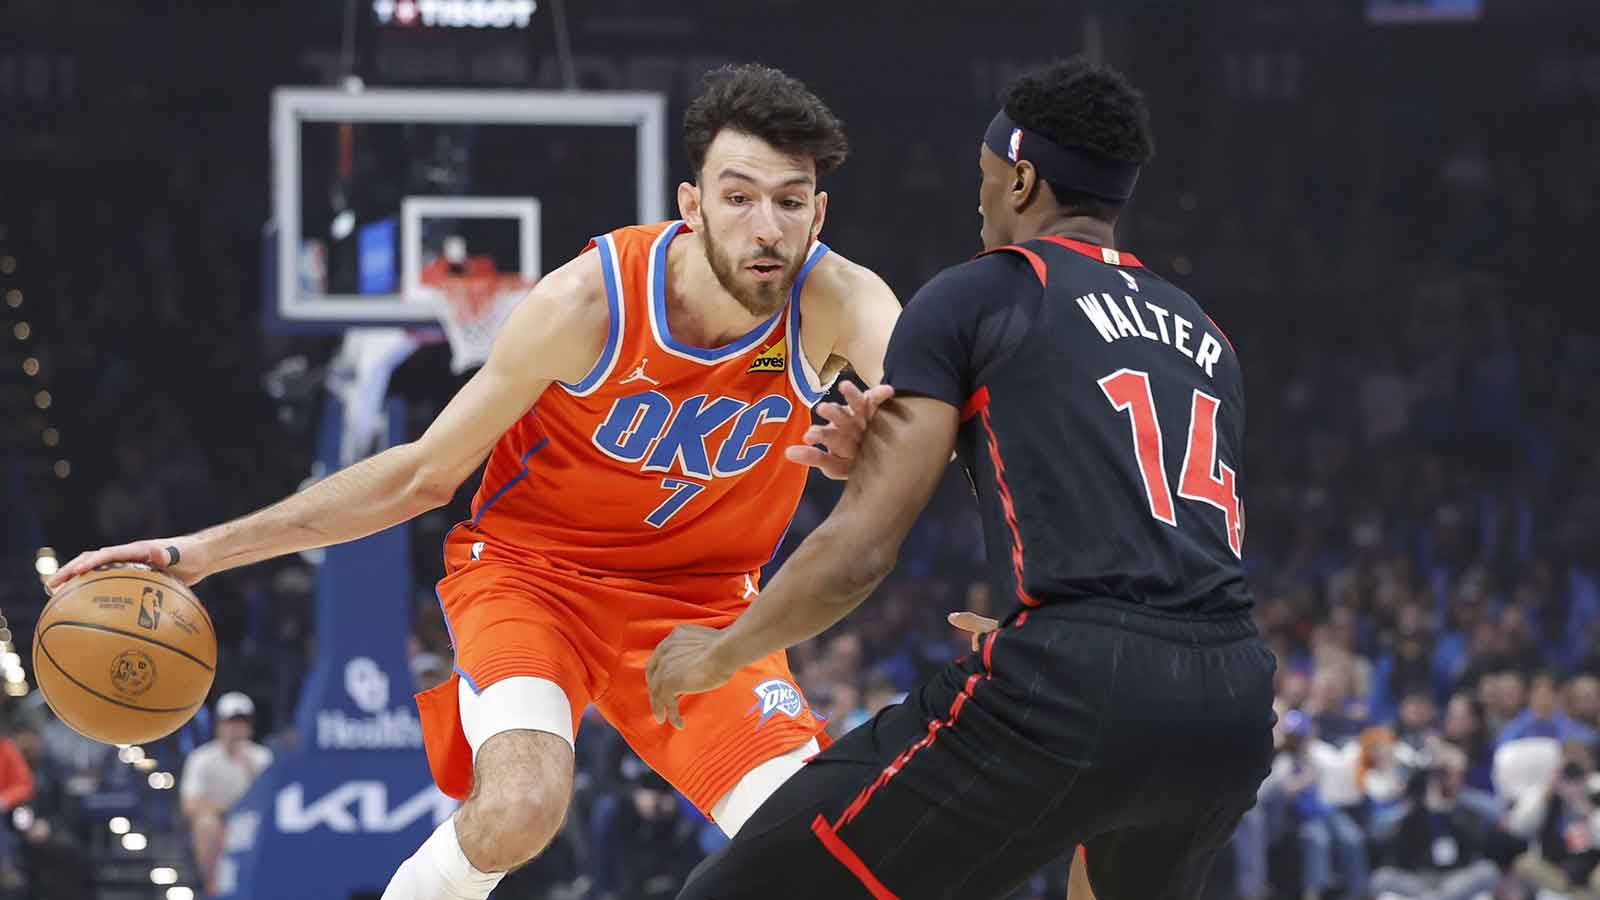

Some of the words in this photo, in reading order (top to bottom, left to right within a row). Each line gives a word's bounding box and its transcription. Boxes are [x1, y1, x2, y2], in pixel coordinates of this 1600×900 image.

[420, 0, 536, 28] TISSOT
[750, 352, 784, 368] ove's
[1076, 292, 1222, 378] WALTER
[592, 390, 792, 480] OKC
[1097, 367, 1241, 560] 14
[644, 478, 705, 528] 7
